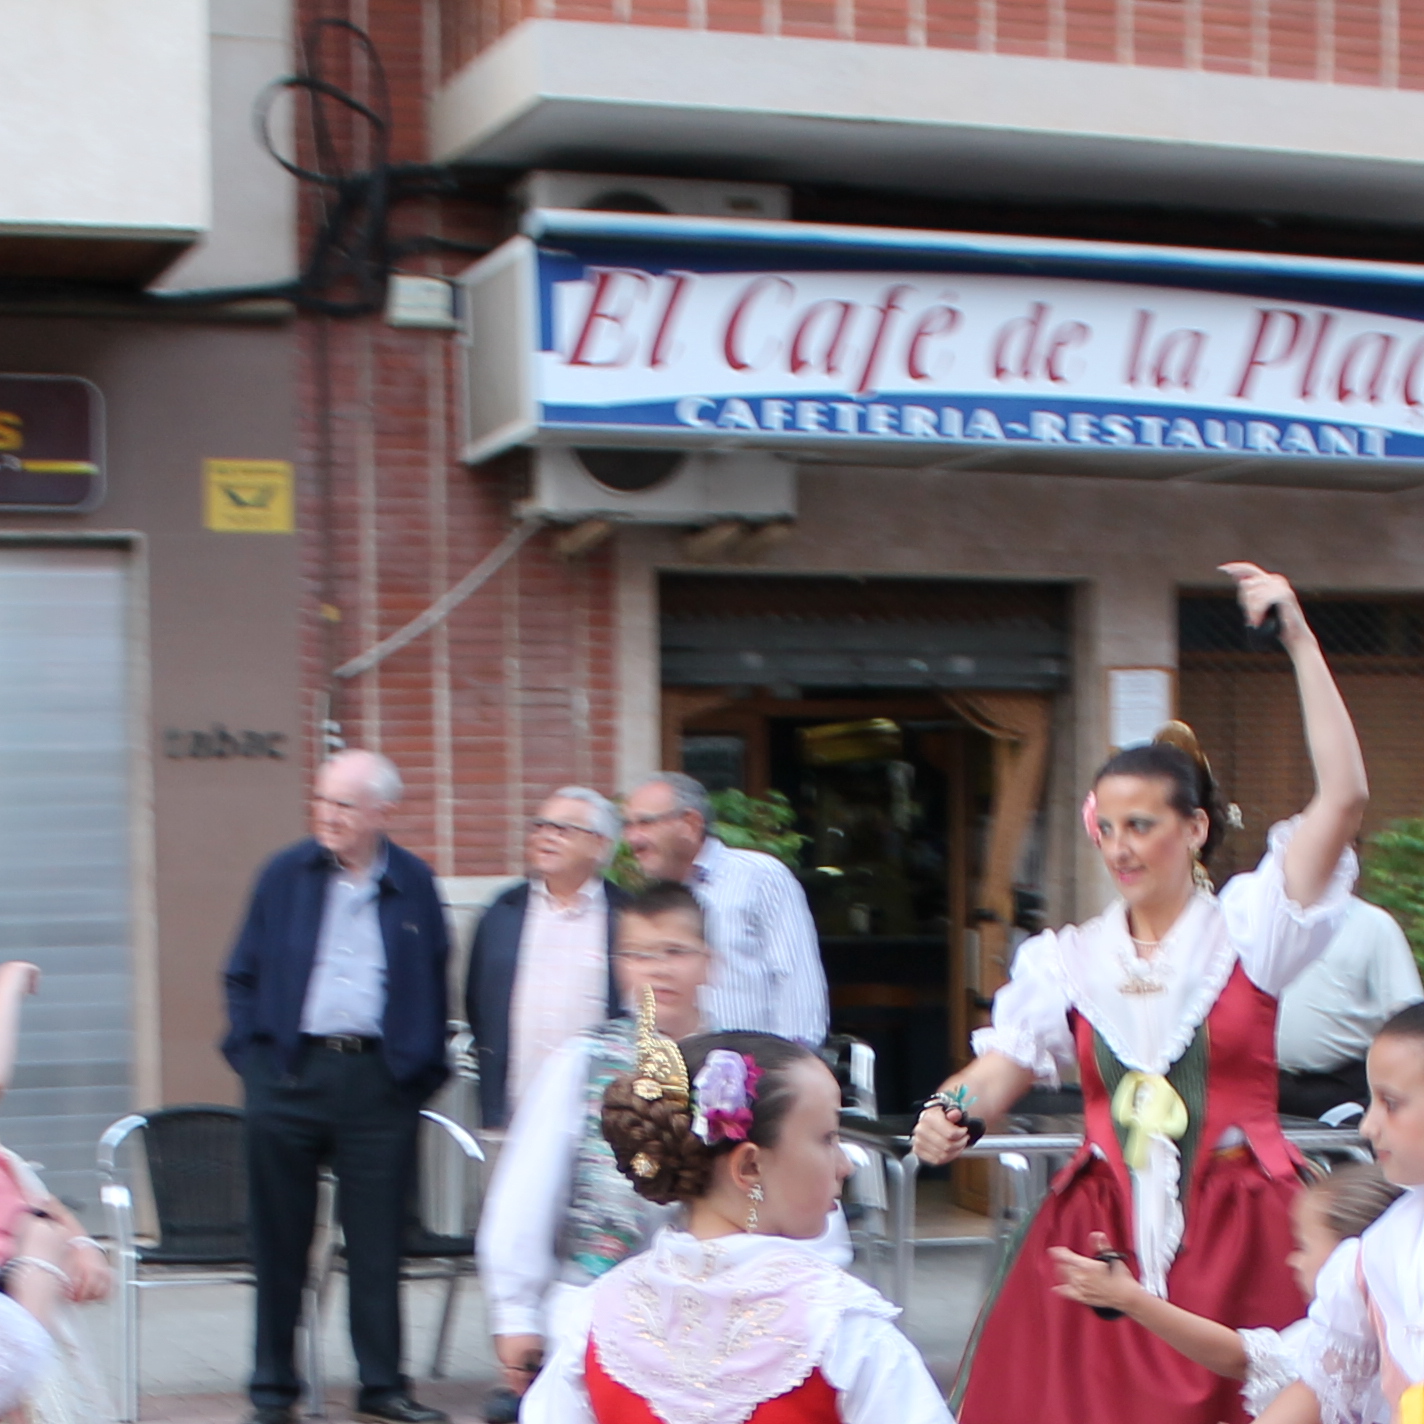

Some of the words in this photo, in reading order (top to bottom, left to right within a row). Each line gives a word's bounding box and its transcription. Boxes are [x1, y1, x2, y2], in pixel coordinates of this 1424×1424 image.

[566, 265, 697, 370] El
[719, 275, 964, 398] Café
[990, 302, 1092, 385] de
[1126, 308, 1209, 393] la
[674, 396, 1390, 457] CAFETERIA-RESTAURANT
